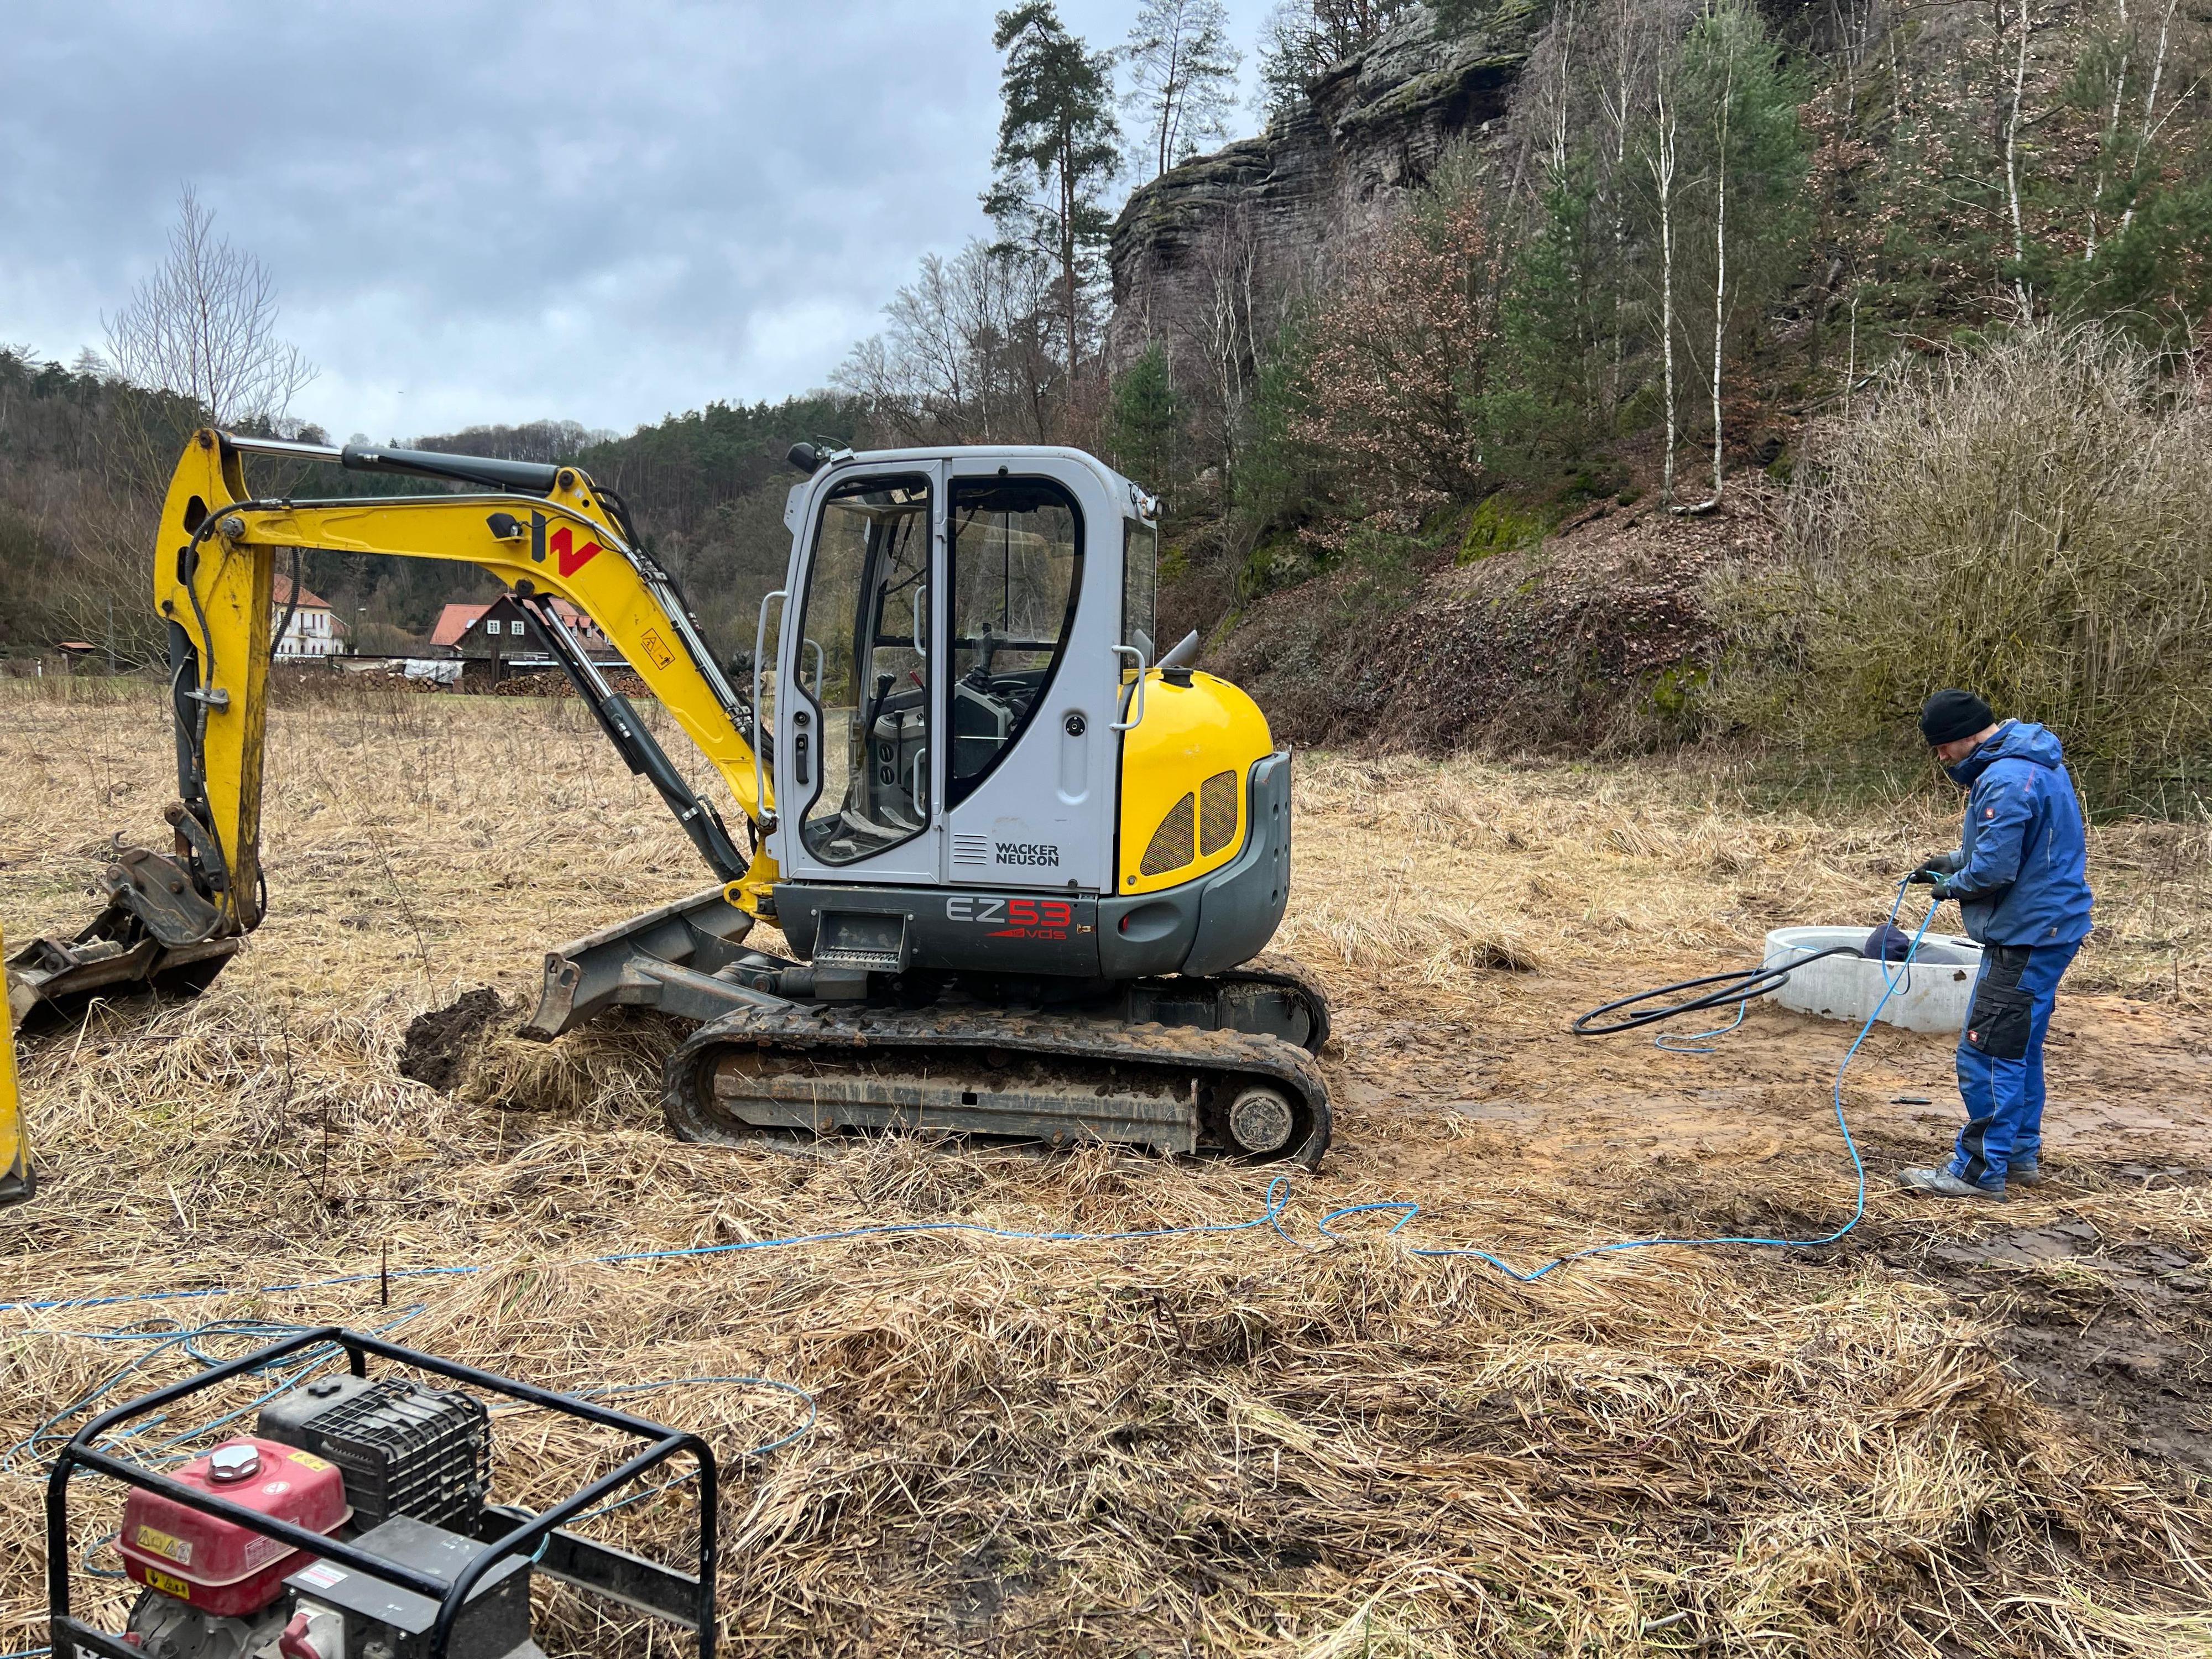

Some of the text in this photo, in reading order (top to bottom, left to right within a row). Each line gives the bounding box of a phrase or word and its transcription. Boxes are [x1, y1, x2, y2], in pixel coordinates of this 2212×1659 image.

[995, 842, 1059, 856] WACKER
[996, 853, 1059, 867] NEUSON
[946, 897, 1071, 927] EZ53
